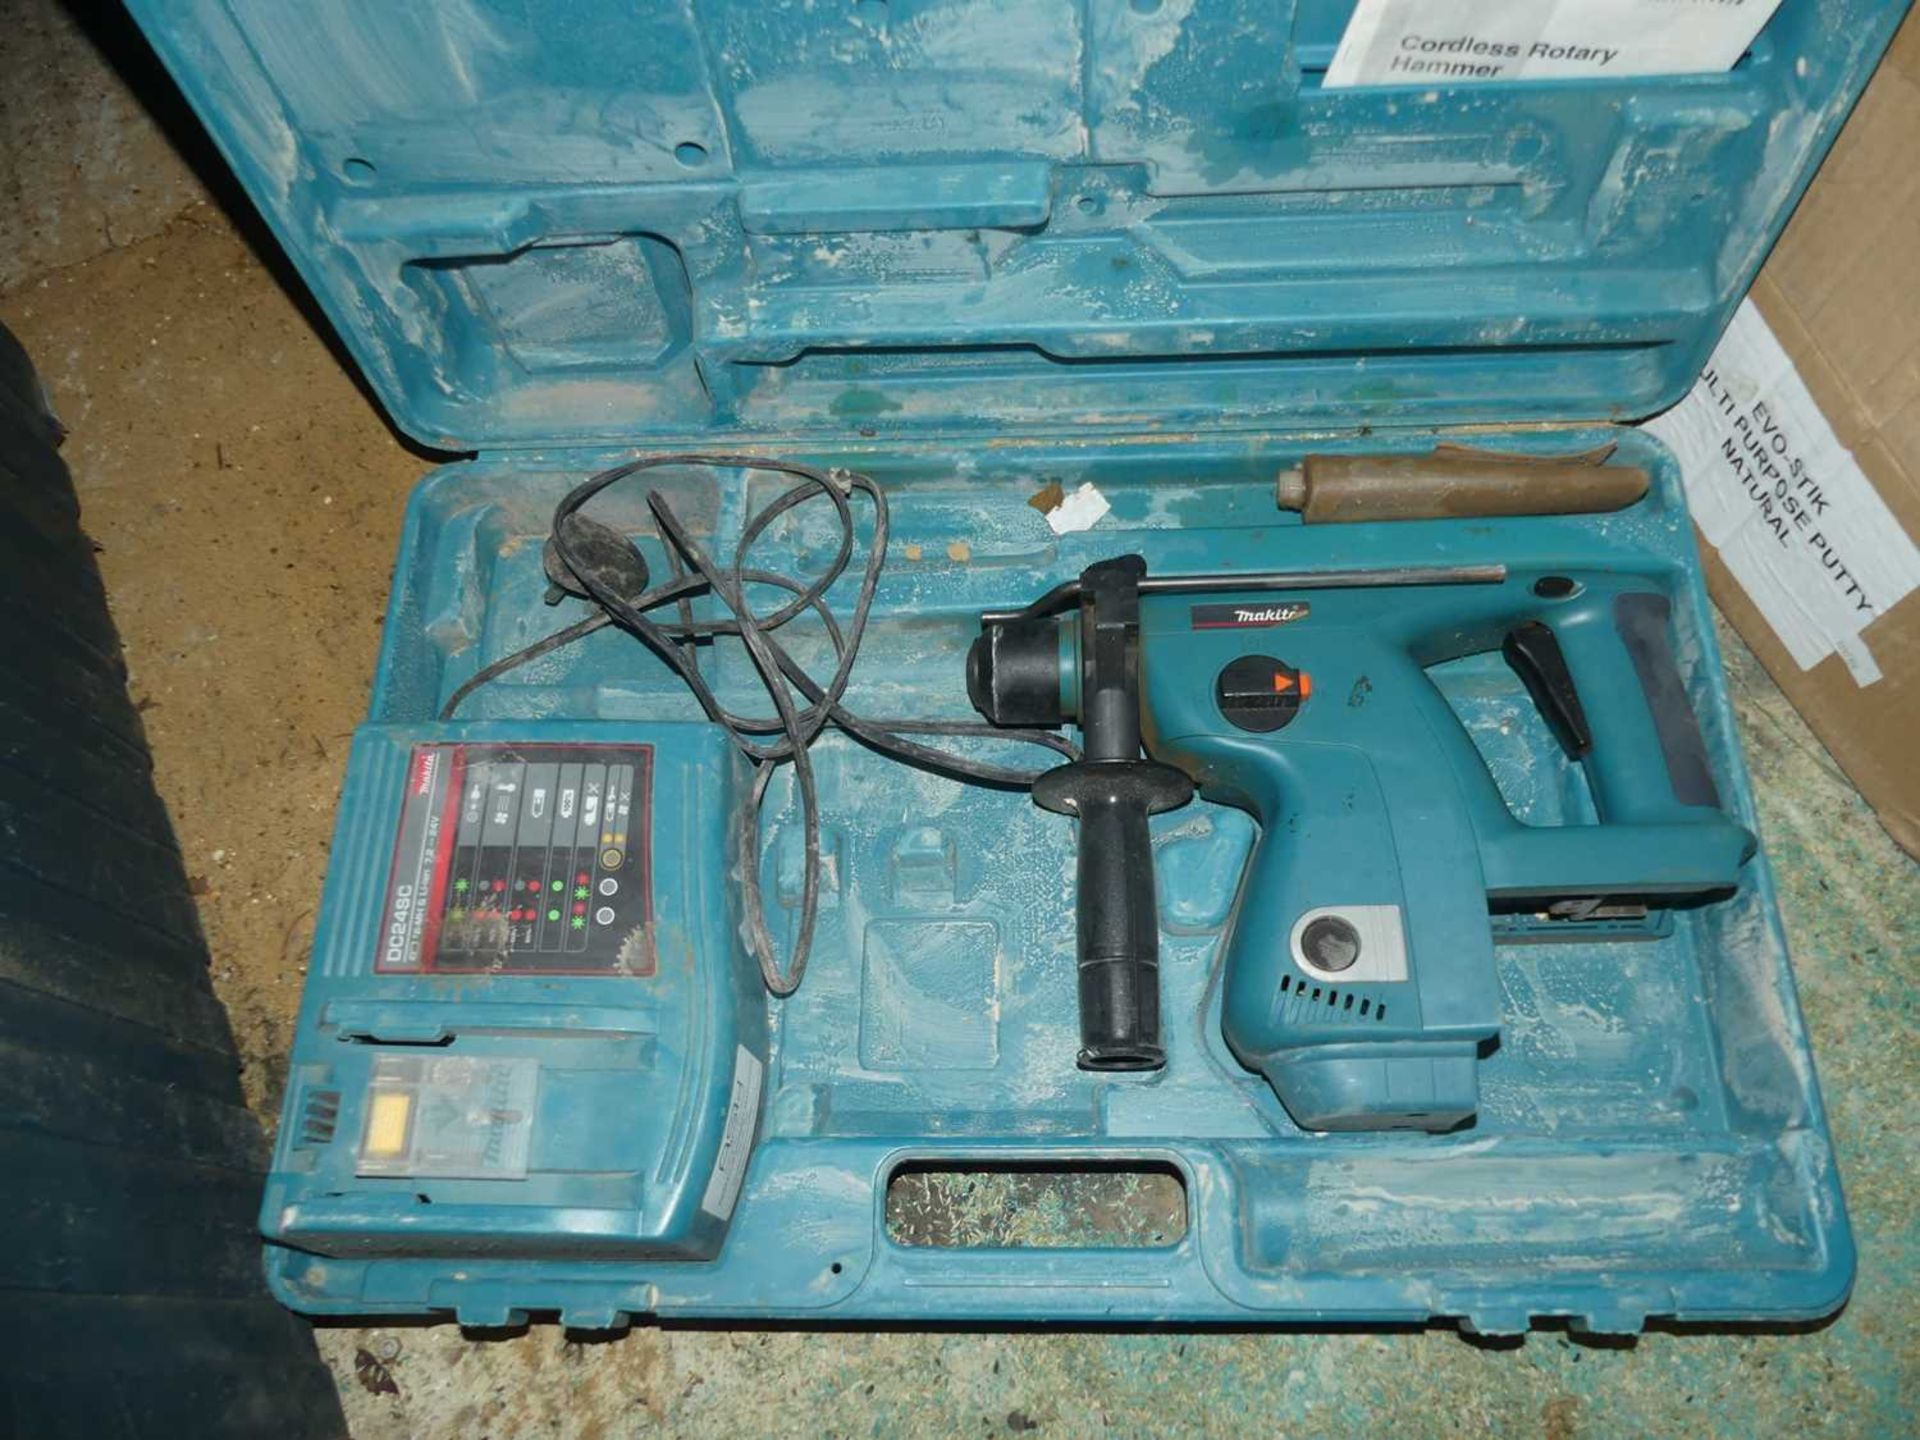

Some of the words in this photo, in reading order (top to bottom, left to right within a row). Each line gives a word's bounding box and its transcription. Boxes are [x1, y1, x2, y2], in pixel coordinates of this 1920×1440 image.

[1390, 55, 1504, 79] Hammer
[1401, 34, 1518, 58] Cordless
[1528, 42, 1619, 66] Rotary
[1700, 368, 1734, 416] ULTI
[1733, 416, 1812, 532] PURPOSE
[1808, 533, 1872, 612] PUTTY
[1721, 437, 1790, 549] NATURAL
[1752, 400, 1830, 516] EVO-STIK
[387, 885, 412, 962] DC24SC
